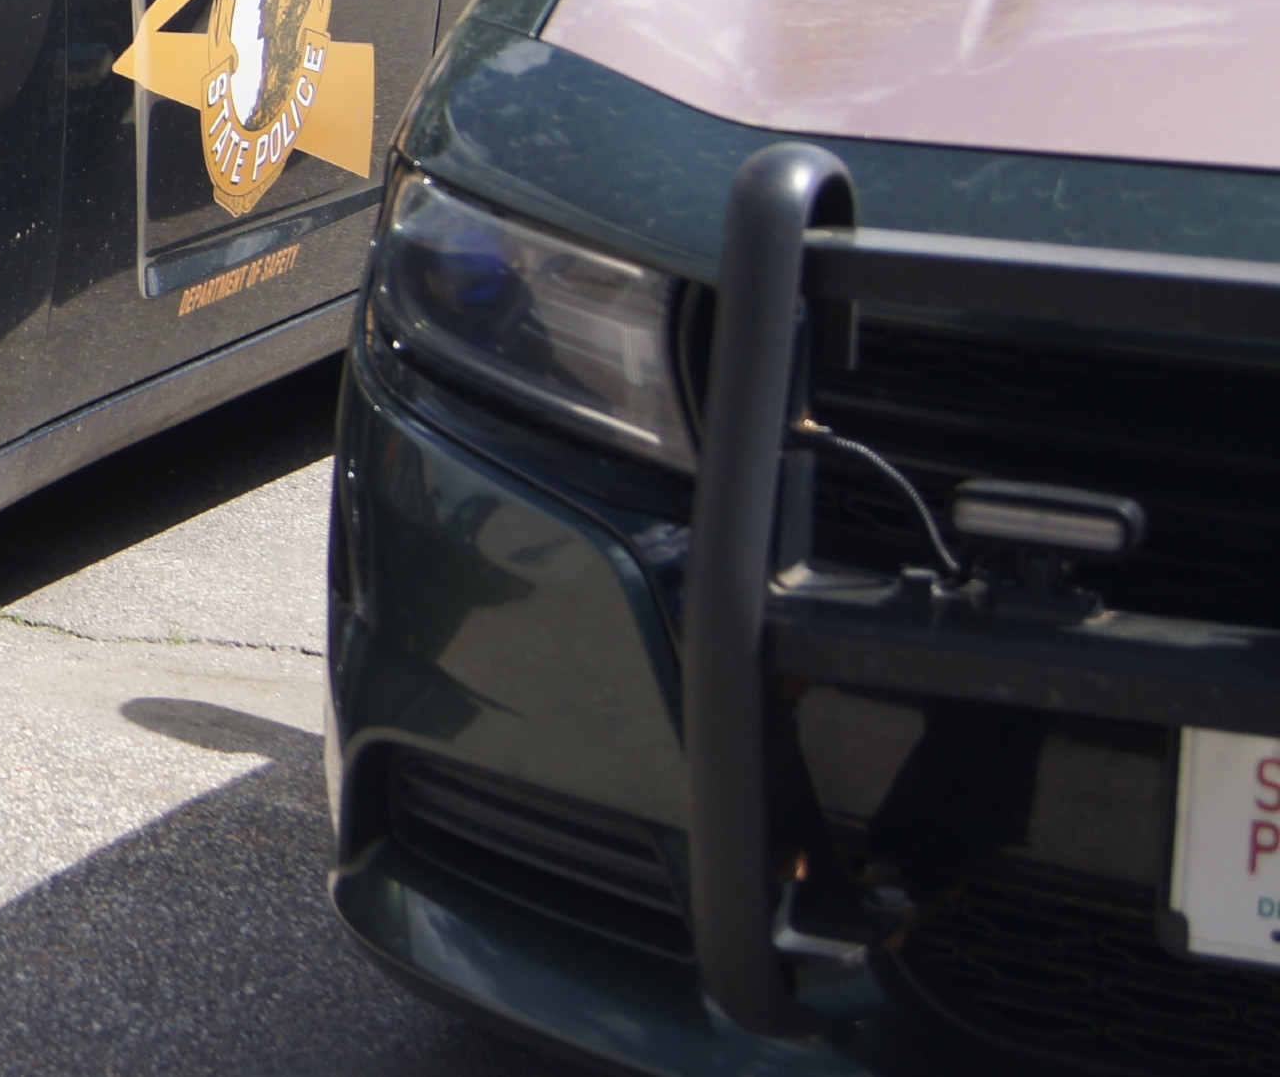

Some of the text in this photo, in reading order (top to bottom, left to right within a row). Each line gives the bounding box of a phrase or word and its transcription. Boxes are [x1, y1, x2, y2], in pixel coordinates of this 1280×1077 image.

[208, 44, 324, 184] STATE POLICE
[178, 243, 301, 317] DEPARTMENT OF SAFETY
